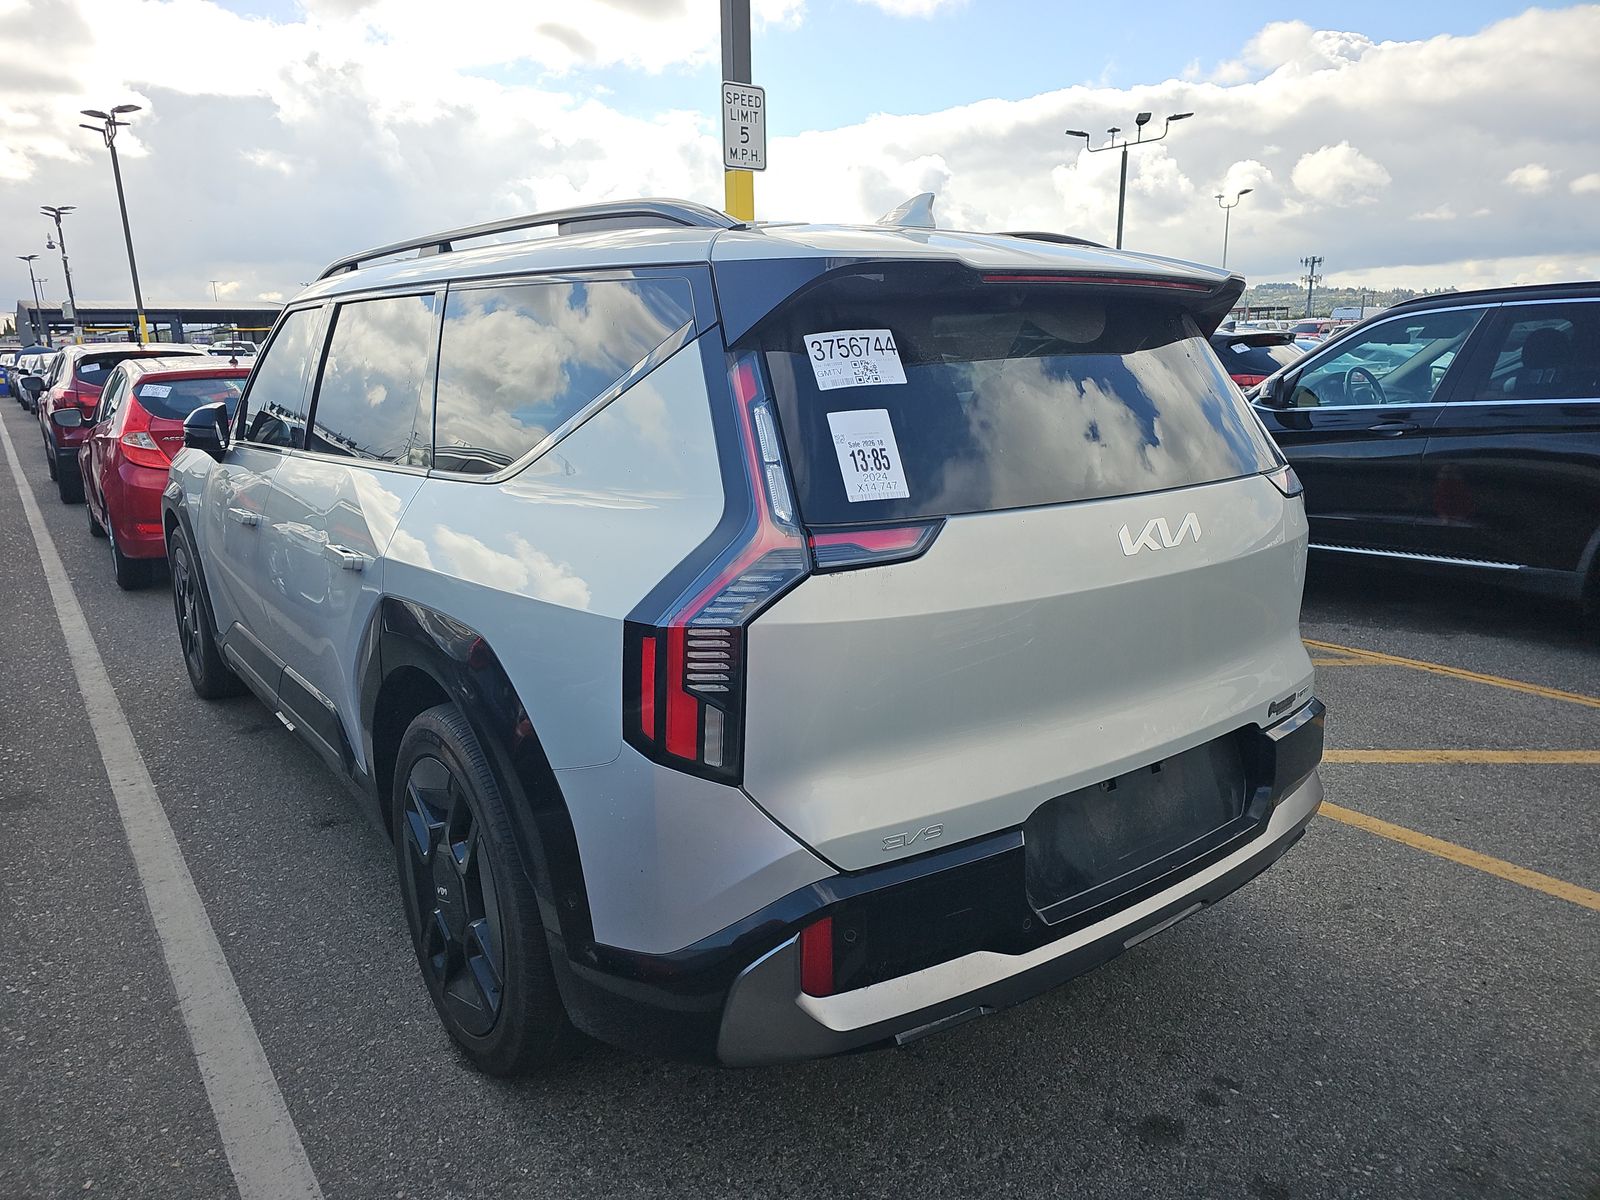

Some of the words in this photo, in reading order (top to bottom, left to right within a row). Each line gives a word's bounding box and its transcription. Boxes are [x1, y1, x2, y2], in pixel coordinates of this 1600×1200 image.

[725, 91, 762, 109] SPEED
[730, 108, 759, 124] LIMIT
[740, 126, 750, 144] 5
[729, 147, 761, 162] M.P.H.
[811, 336, 897, 361] 3756744
[816, 368, 843, 378] GMTV
[847, 440, 861, 449] Sale
[849, 447, 891, 473] 13:85
[862, 472, 888, 483] 2024
[1117, 511, 1202, 557] KIA
[881, 822, 944, 852] EV9
